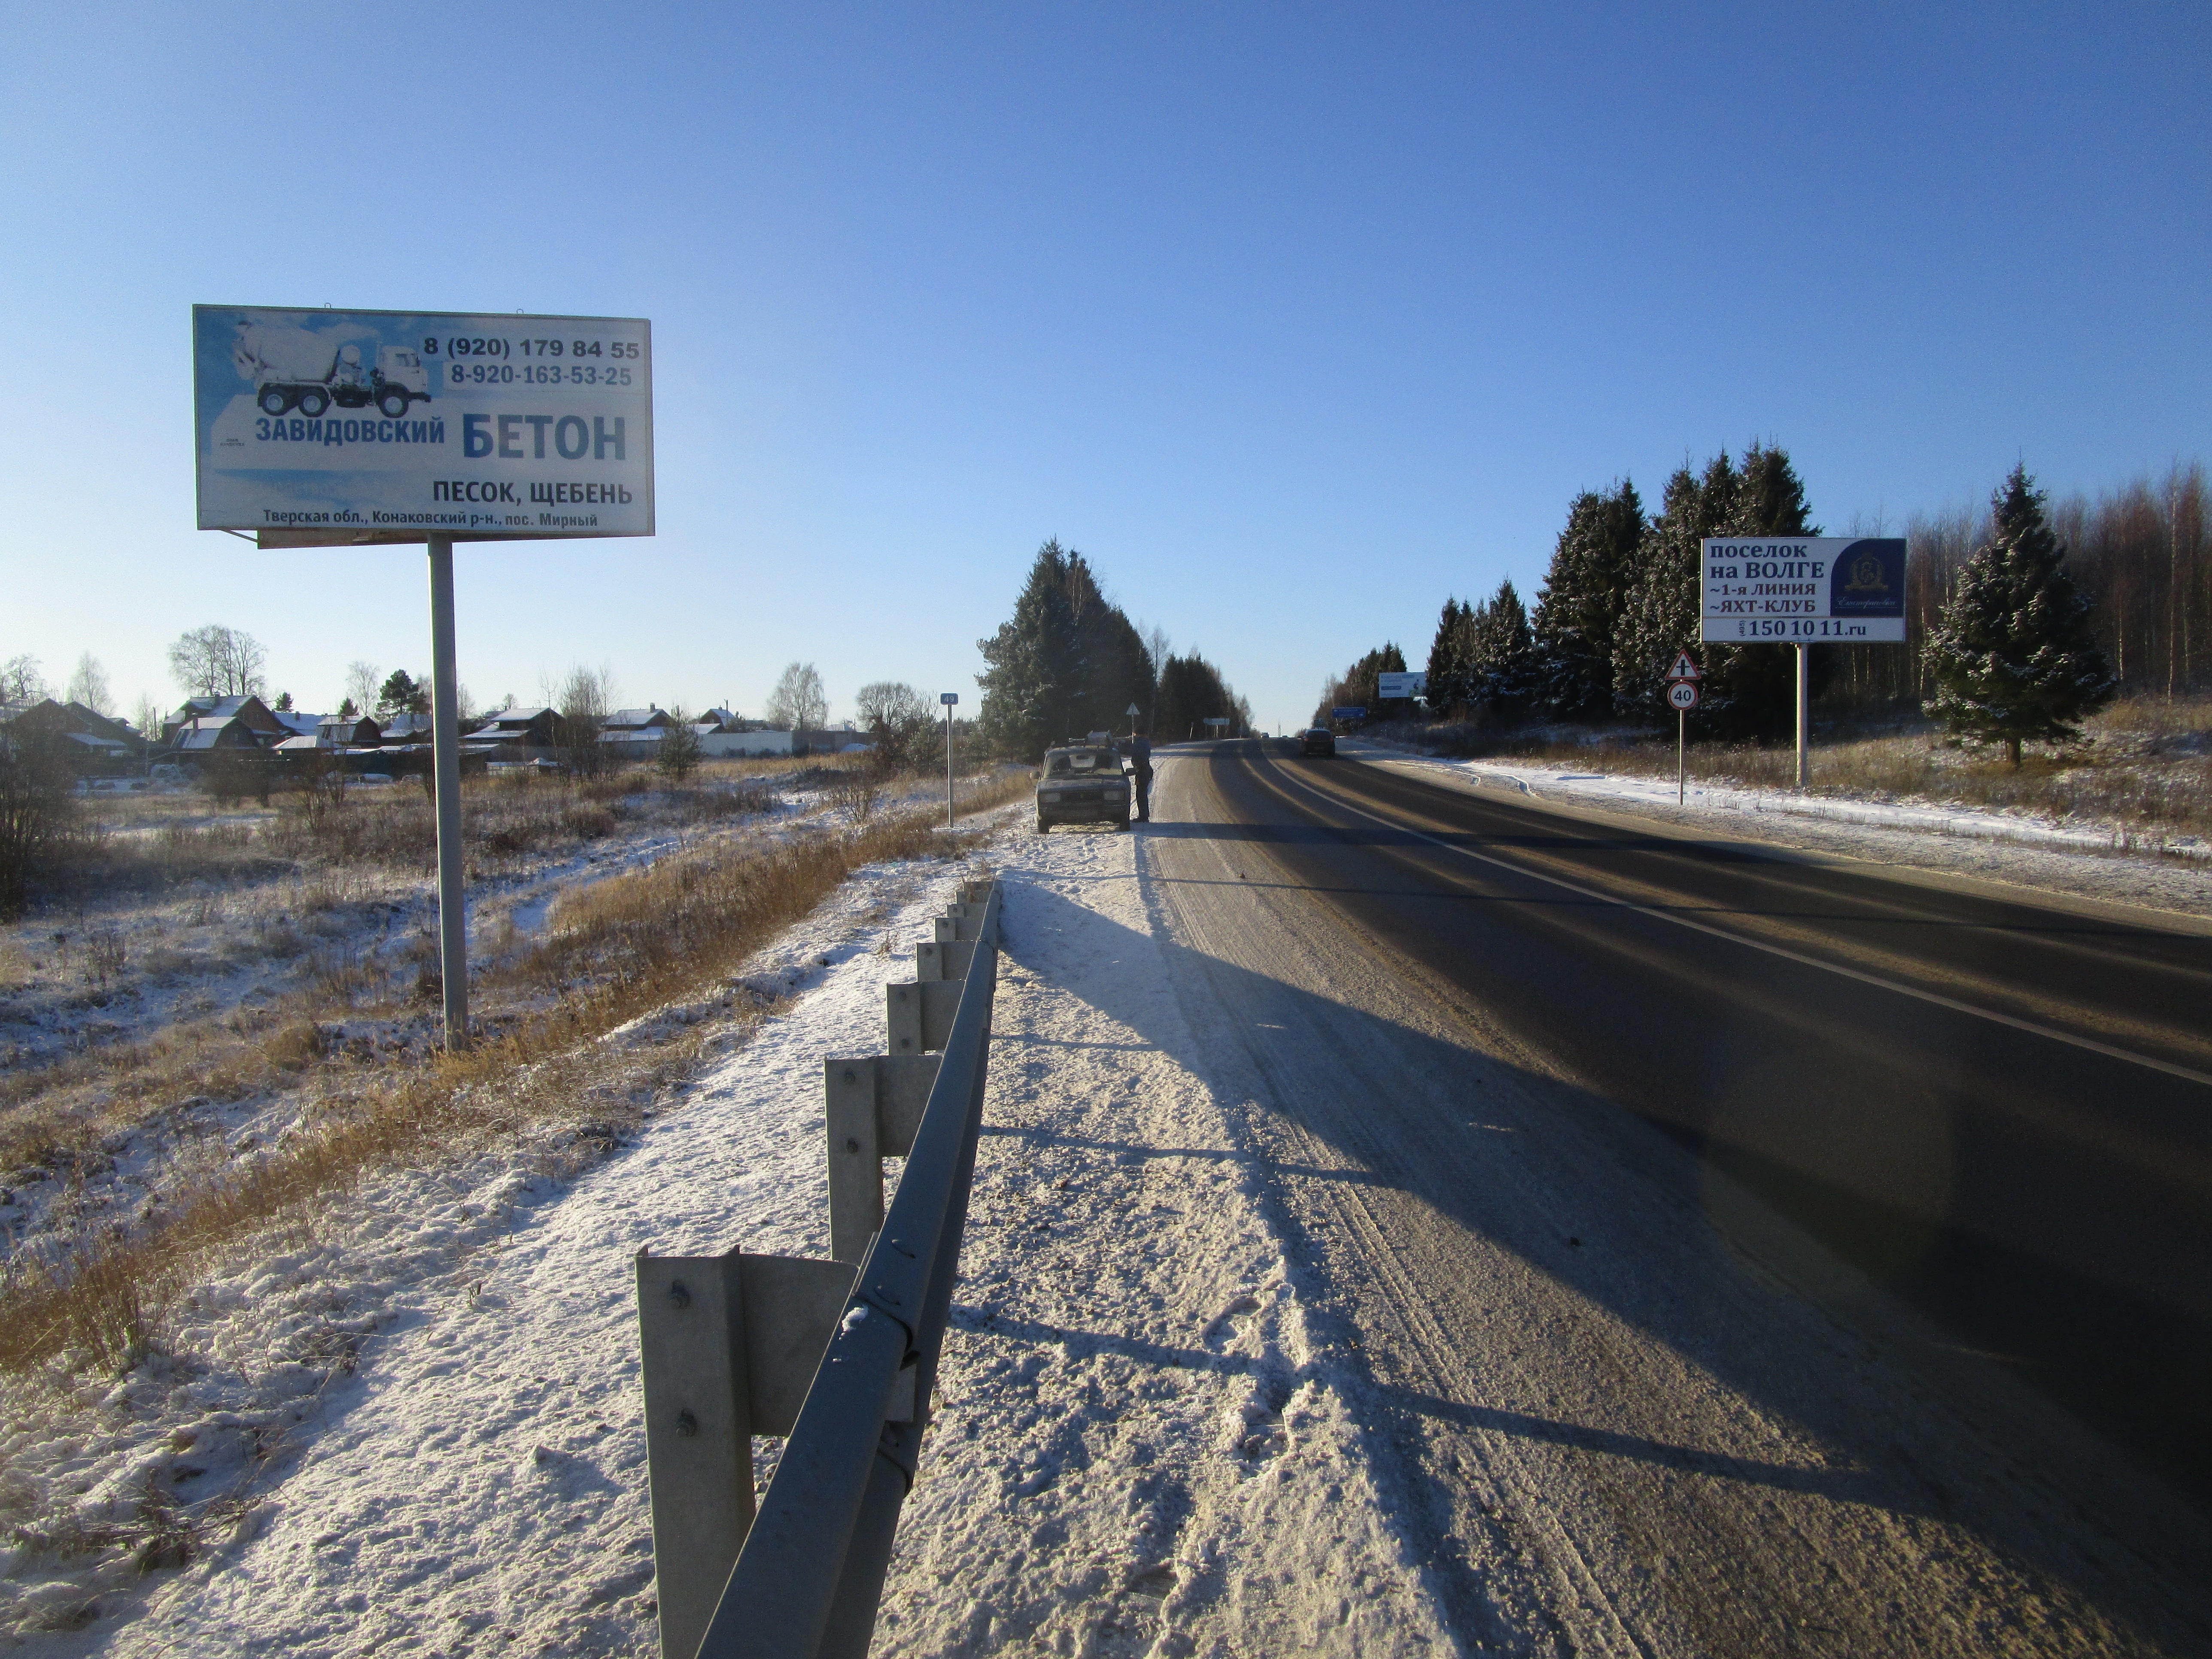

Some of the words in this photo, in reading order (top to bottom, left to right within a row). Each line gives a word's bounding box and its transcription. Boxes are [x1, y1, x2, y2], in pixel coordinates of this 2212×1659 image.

[424, 337, 438, 355] 8
[448, 337, 510, 360] (920)
[520, 339, 564, 357] 179
[572, 340, 602, 358] 84
[611, 342, 640, 359] 55
[451, 364, 632, 386] 8-920-163-53-25
[255, 416, 445, 446] ЗАВИДОВСКИЙ
[463, 413, 626, 460] БЕТОН
[433, 480, 521, 506] ПЕСОК,
[530, 483, 633, 507] ЩЕБЕНЬ
[263, 509, 329, 525] Тверская
[334, 509, 368, 525] обл.,
[373, 510, 466, 524] Конаковский
[471, 515, 501, 527] р-н.,
[505, 515, 534, 526] пос.
[539, 513, 598, 529] Мирный
[1710, 545, 1808, 558] поселок
[1710, 566, 1738, 579] на
[1744, 562, 1824, 579] ВОЛГЕ
[1751, 583, 1816, 596] ЛИНИЯ
[1749, 620, 1786, 636] 150
[1791, 620, 1815, 636] 10
[1674, 690, 1691, 701] 40
